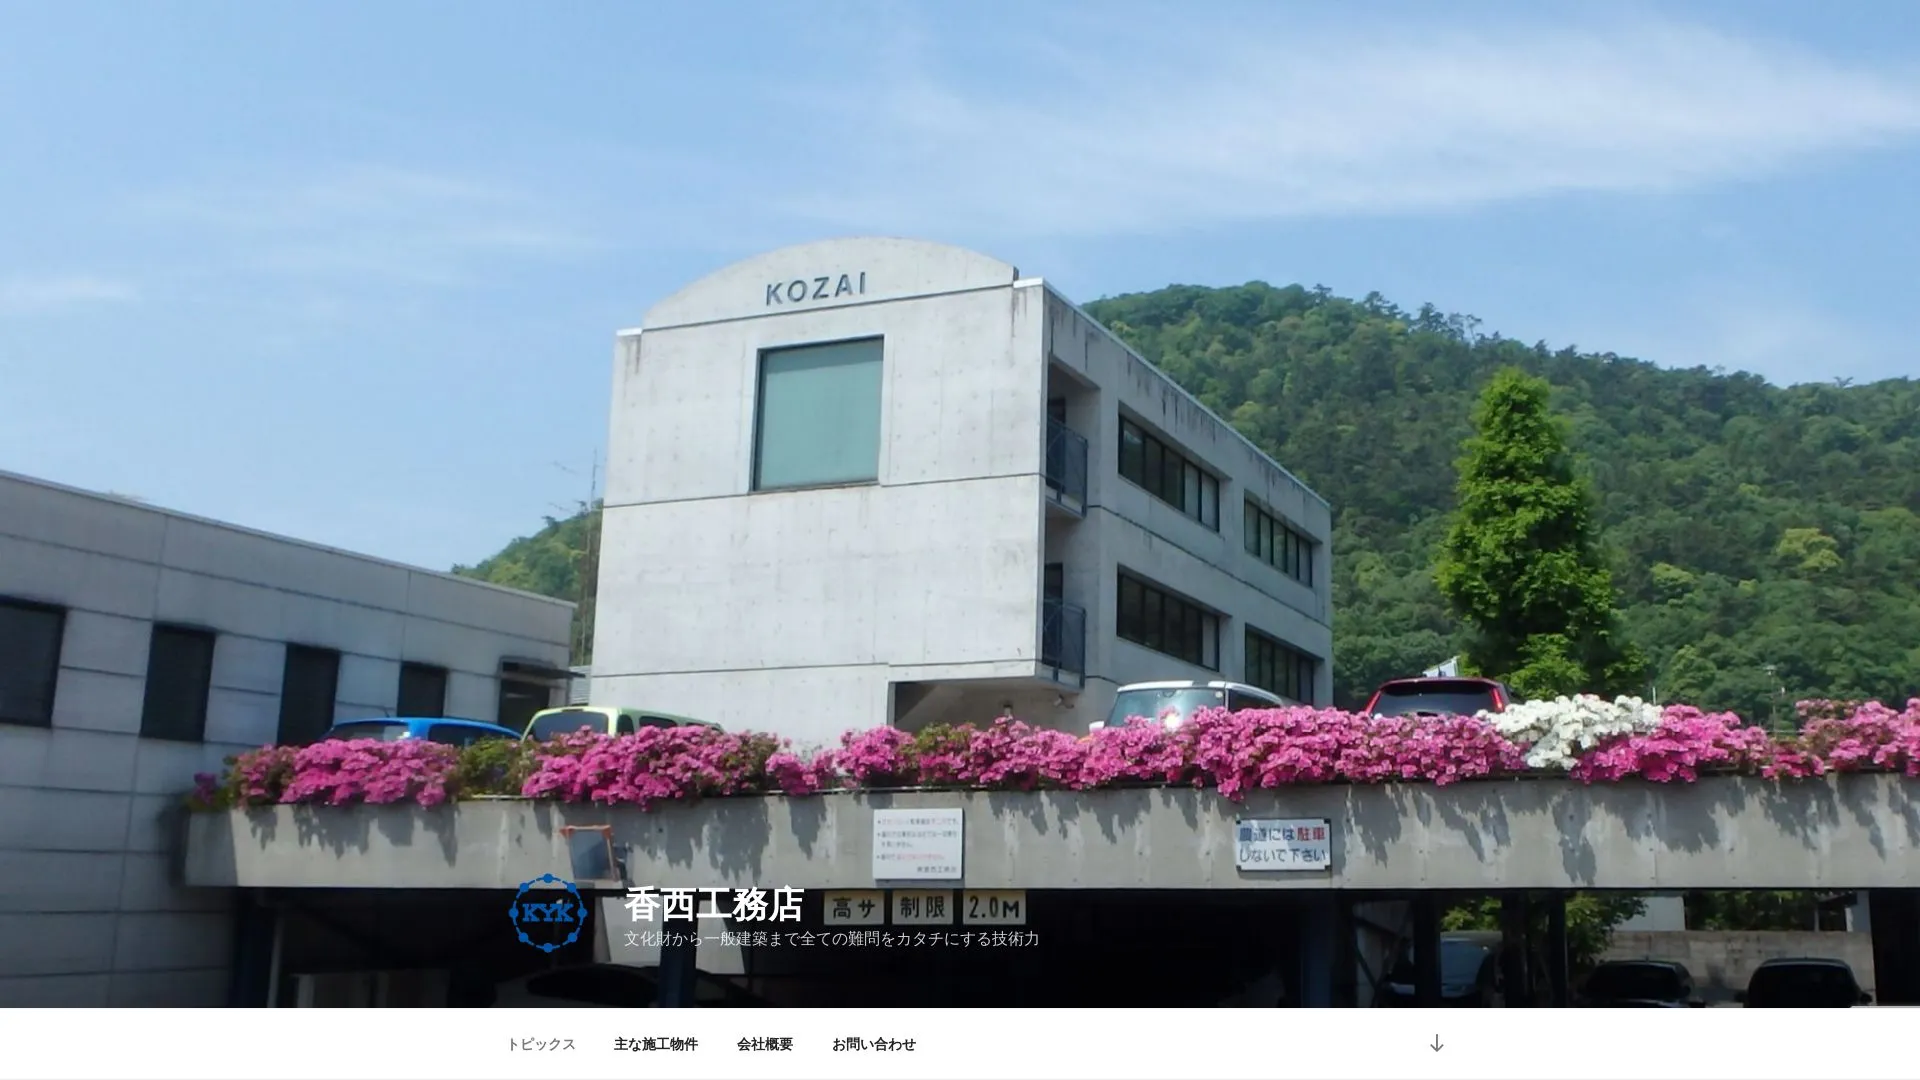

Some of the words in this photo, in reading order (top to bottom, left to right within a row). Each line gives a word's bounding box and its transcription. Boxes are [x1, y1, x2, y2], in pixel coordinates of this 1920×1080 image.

[766, 271, 866, 306] KOZAI
[1240, 848, 1327, 863] しないで下さい
[900, 896, 945, 919] 制限
